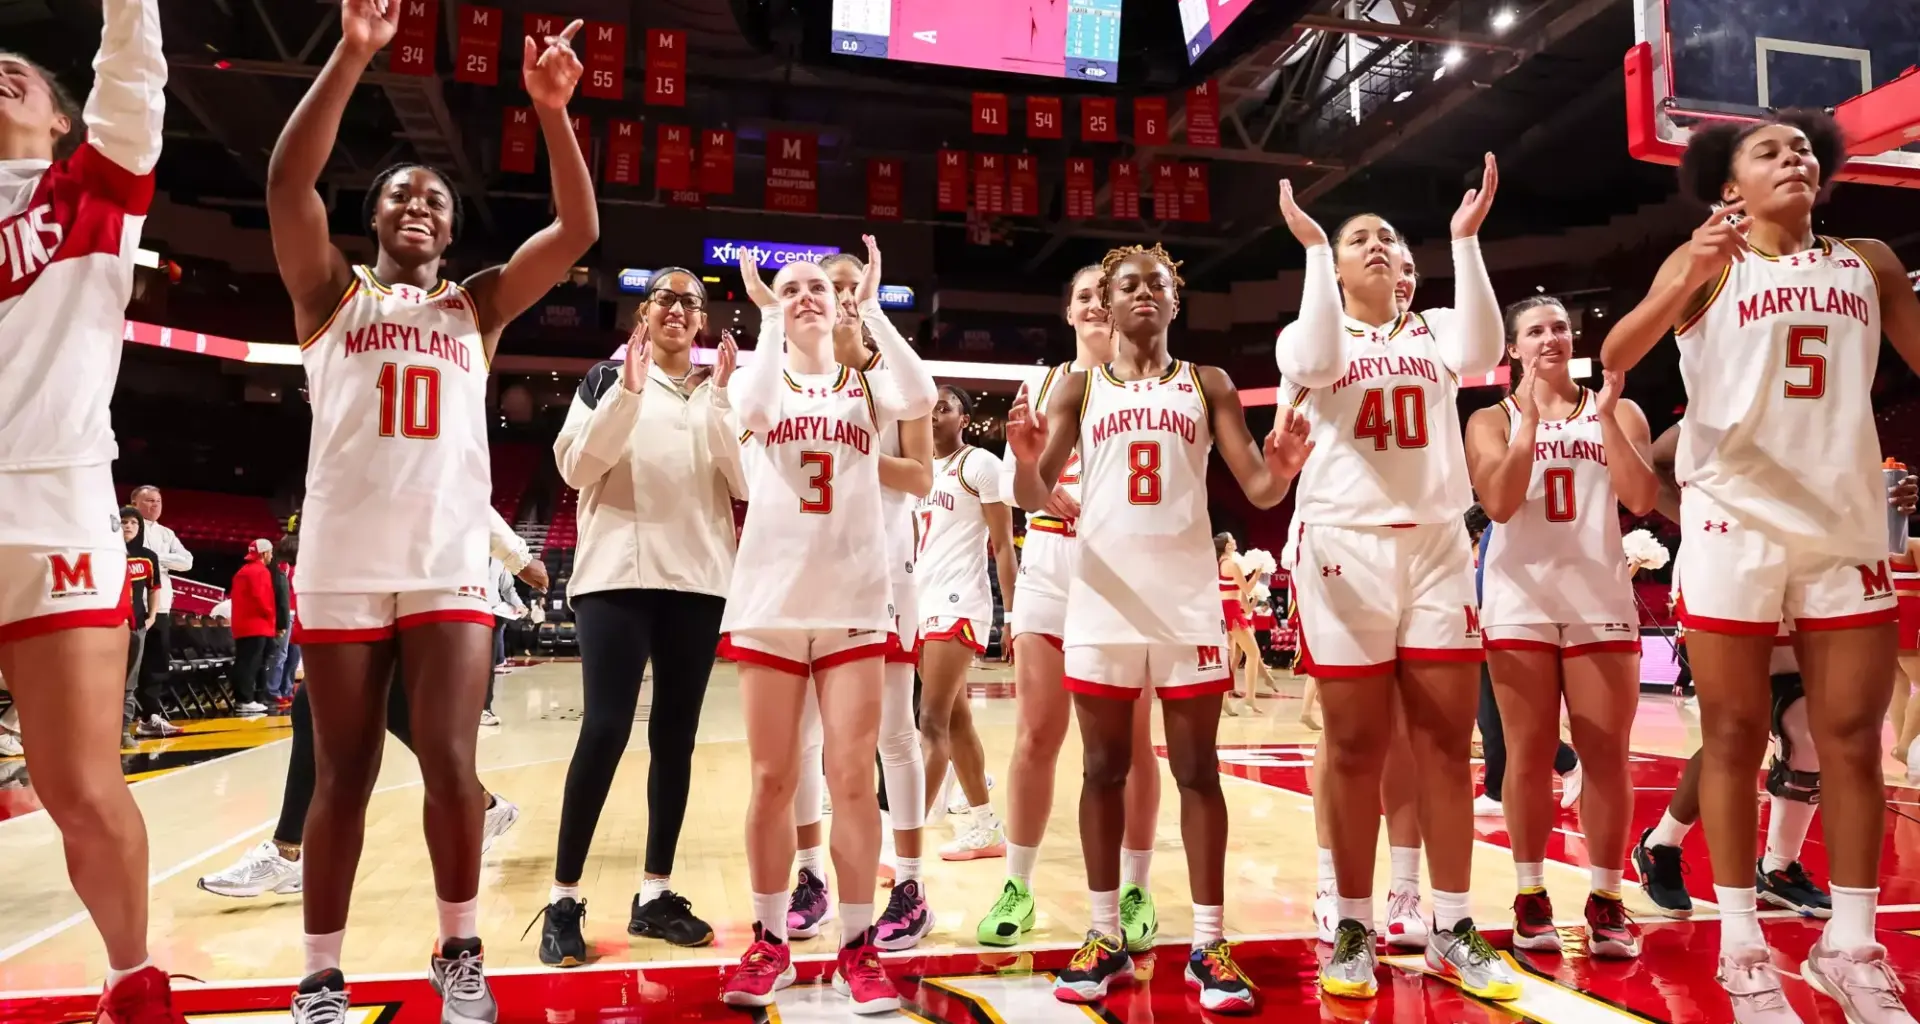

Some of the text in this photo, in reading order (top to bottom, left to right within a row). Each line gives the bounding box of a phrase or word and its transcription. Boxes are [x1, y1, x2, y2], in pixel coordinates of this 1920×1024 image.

[408, 1, 425, 17] M
[472, 10, 488, 26] M
[536, 19, 551, 34] M
[598, 27, 613, 42] M
[659, 35, 673, 49] M
[912, 30, 937, 44] A
[842, 40, 858, 51] 0.0
[401, 45, 424, 64] 34
[466, 54, 488, 73] 25
[592, 70, 613, 88] 55
[655, 77, 674, 94] 15
[1196, 82, 1208, 96] M
[514, 110, 527, 124] M
[980, 107, 998, 124] 41
[1035, 112, 1053, 128] 54
[619, 123, 631, 137] M
[1089, 116, 1107, 132] 25
[1146, 119, 1156, 135] 6
[668, 129, 680, 142] M
[712, 133, 724, 147] M
[782, 138, 802, 160] M
[946, 153, 958, 166] M
[983, 156, 995, 169] M
[1017, 158, 1029, 171] M
[772, 167, 810, 179] NATIONAL
[878, 162, 891, 177] M
[1073, 162, 1085, 174] M
[1119, 164, 1130, 176] M
[1160, 165, 1171, 177] M
[1188, 166, 1200, 179] M
[672, 190, 700, 203] 2001
[774, 192, 807, 207] 2002
[870, 204, 897, 217] 2002
[0, 204, 63, 282] INS
[774, 249, 824, 264] cente
[1738, 286, 1868, 328] MARYLAND
[344, 322, 470, 373] MARYLAND
[1784, 325, 1828, 399] 5
[376, 362, 441, 439] 10
[1354, 385, 1429, 451] 40
[766, 416, 870, 455] MARYLAND
[1092, 408, 1196, 448] MARYLAND
[1534, 440, 1608, 466] RYLAND
[1128, 440, 1161, 505] 8
[800, 451, 833, 514] 3
[1544, 467, 1577, 522] 0
[47, 552, 97, 592] M
[1856, 560, 1892, 596] M
[1196, 645, 1221, 667] M
